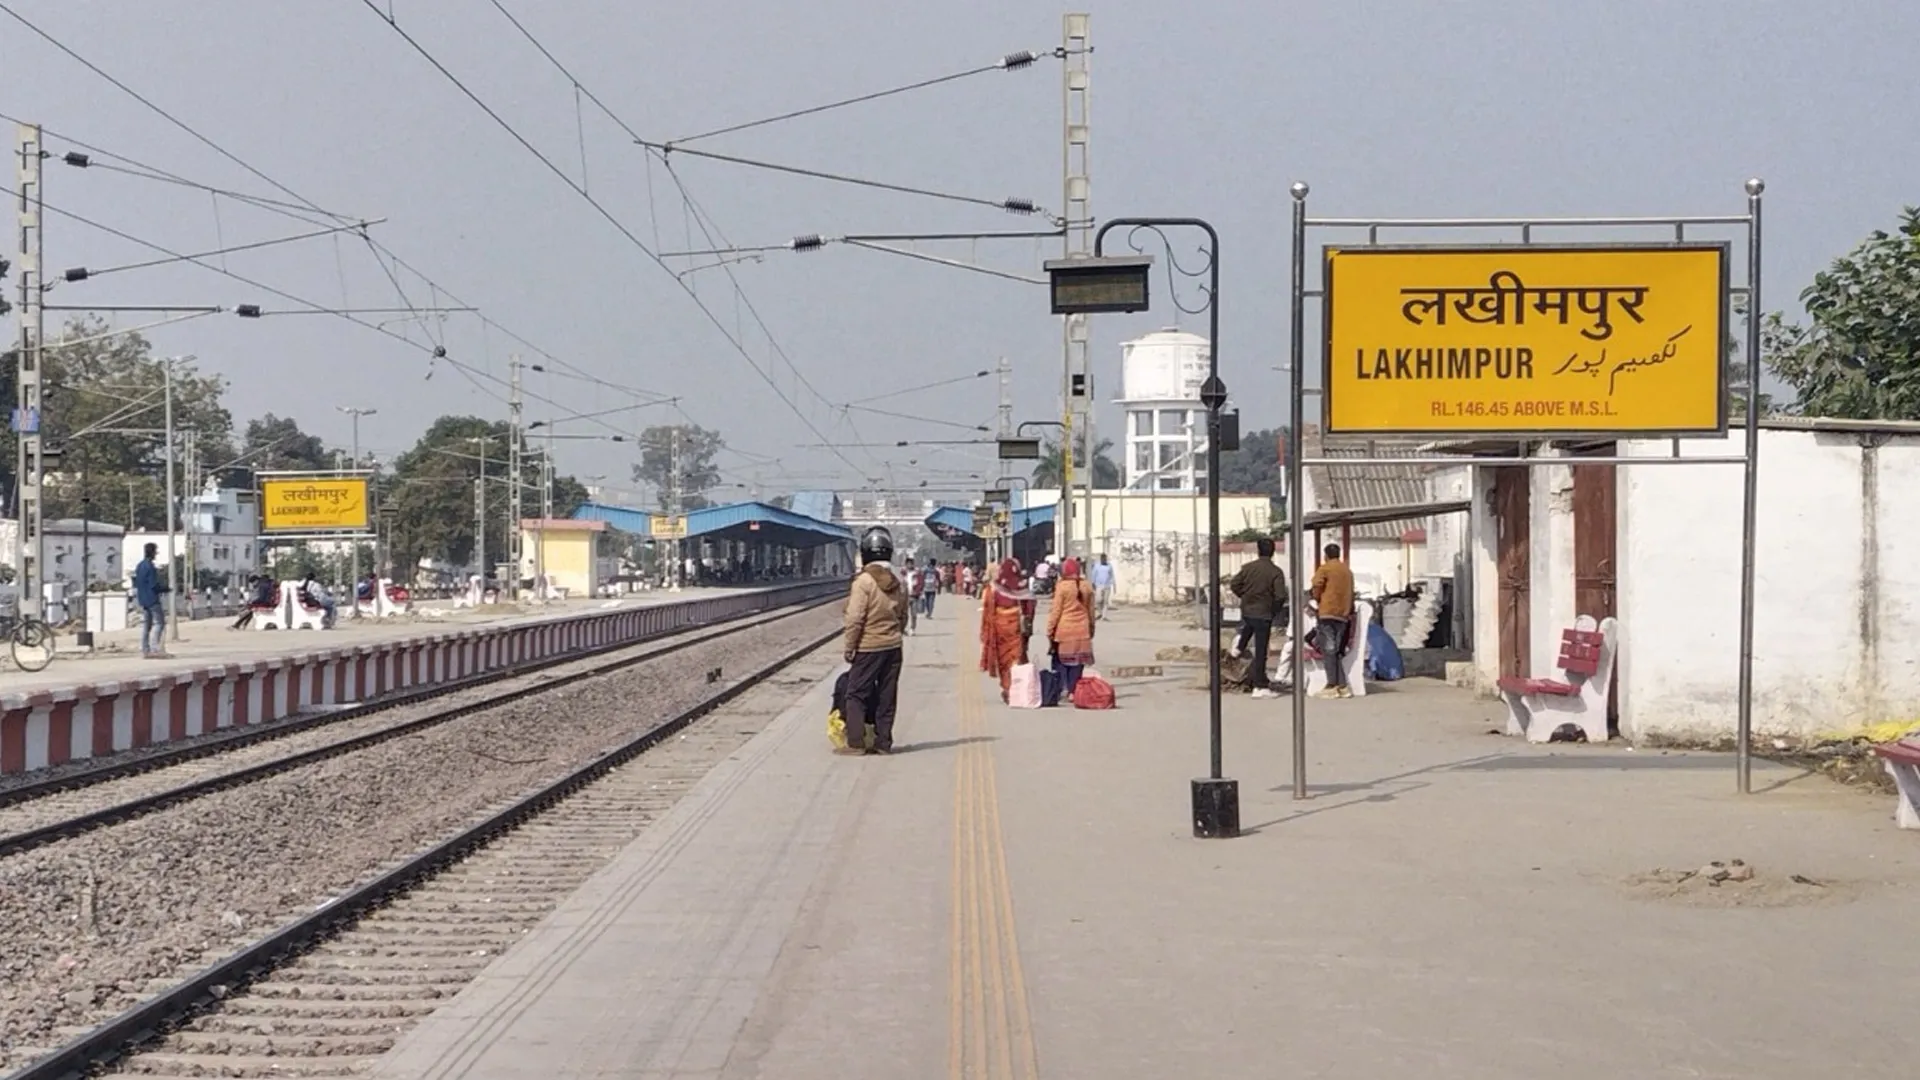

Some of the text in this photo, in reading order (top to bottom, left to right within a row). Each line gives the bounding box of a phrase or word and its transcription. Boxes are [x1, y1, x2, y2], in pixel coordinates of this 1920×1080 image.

[1400, 271, 1650, 341] लखीमपुर
[1357, 347, 1534, 380] LAKHIMPUR
[1431, 401, 1619, 417] RL.146.45 ABOVE M.S.L.
[282, 485, 349, 505] लखीमपुर
